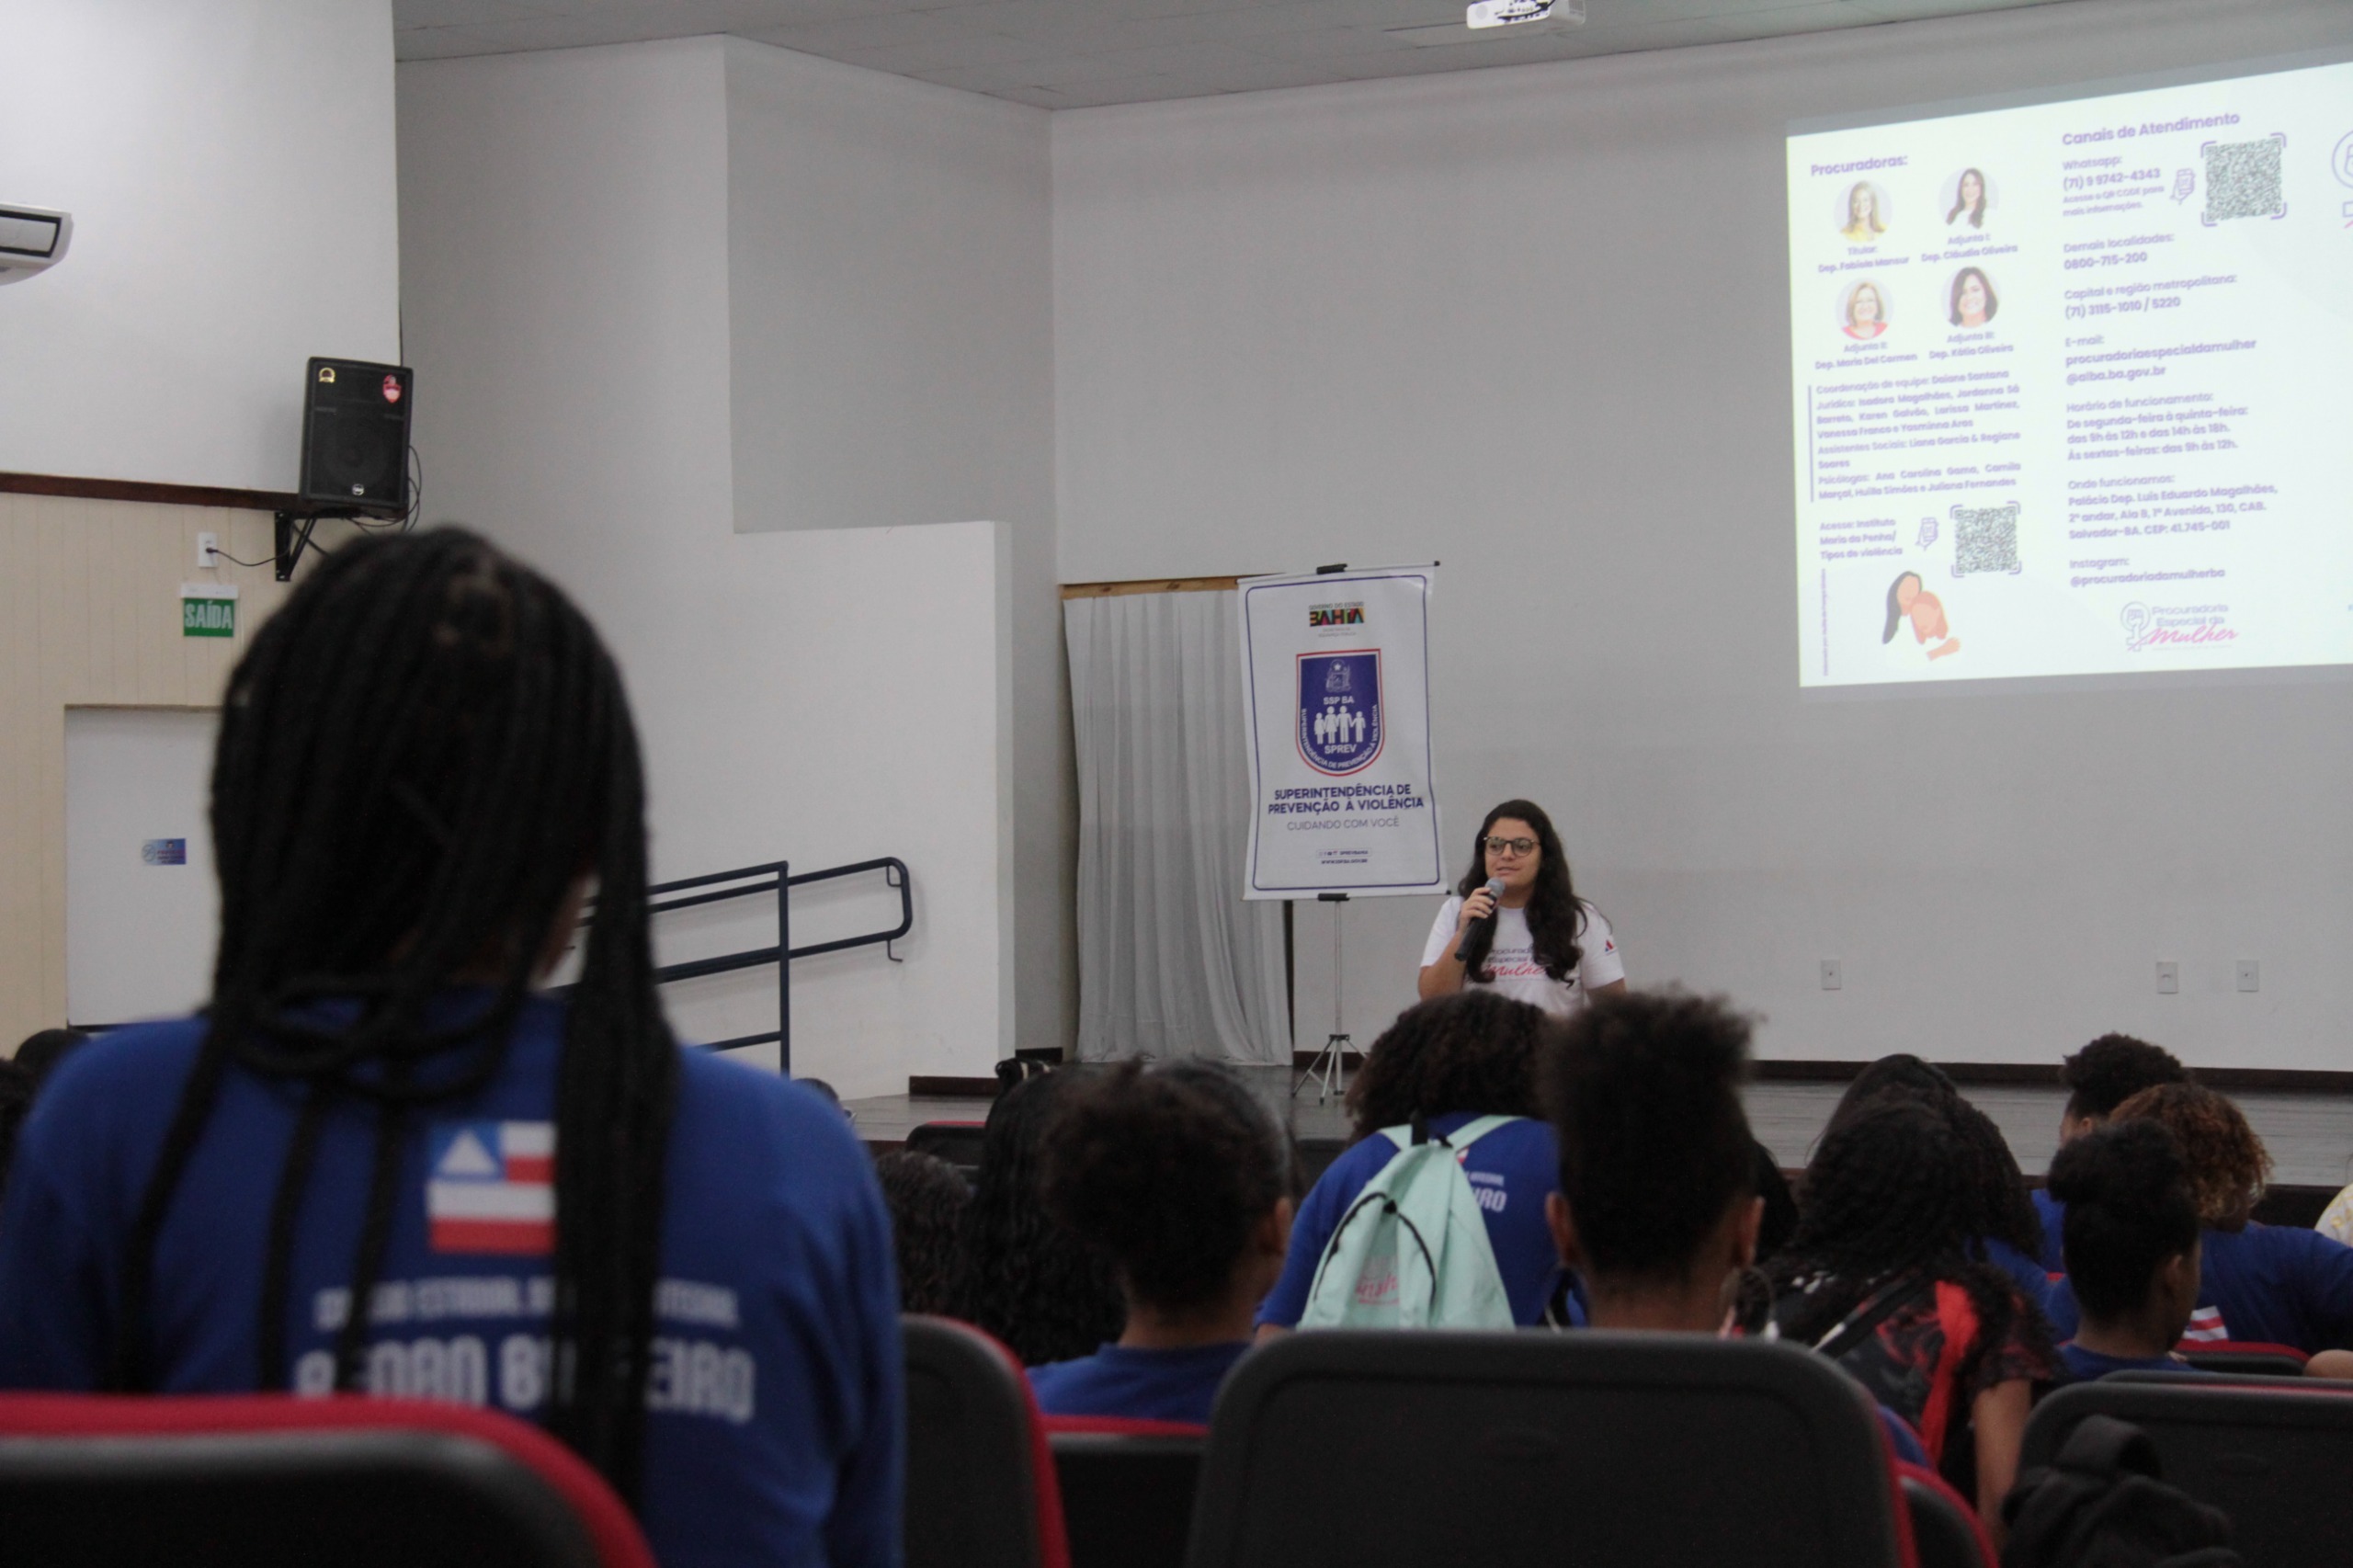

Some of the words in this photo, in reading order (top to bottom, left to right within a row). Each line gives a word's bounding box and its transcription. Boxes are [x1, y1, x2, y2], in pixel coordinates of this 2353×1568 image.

[2062, 128, 2115, 145] Canais
[2117, 125, 2136, 139] de
[2139, 113, 2240, 136] Atendimento
[1811, 155, 1907, 176] Procuradoras:
[2063, 176, 2085, 191] (71)
[2095, 167, 2161, 186] 9742-4343
[2063, 251, 2148, 270] 0800-715-200
[2115, 282, 2152, 297] região
[2153, 275, 2237, 290] metropolitana:
[2064, 304, 2086, 320] (71)
[1880, 380, 1894, 389] de
[2066, 401, 2108, 413] Horário
[2107, 399, 2123, 410] de
[2124, 392, 2213, 408] funcionamento:
[1845, 550, 1859, 558] de
[185, 600, 233, 629] SAÍDA
[1324, 696, 1340, 705] SSP
[1342, 696, 1355, 704] BA
[1324, 744, 1357, 754] SPREV
[1275, 783, 1394, 800] SUPERINTENDÊNCIA
[1396, 784, 1411, 795] DE
[1268, 798, 1340, 815] PREVENÇÃO
[1345, 798, 1355, 811] À
[1358, 795, 1424, 812] VIOLÊNCIA
[1287, 819, 1340, 831] CUIDANDO
[1343, 818, 1368, 829] COM
[1370, 815, 1400, 827] VOCÊ
